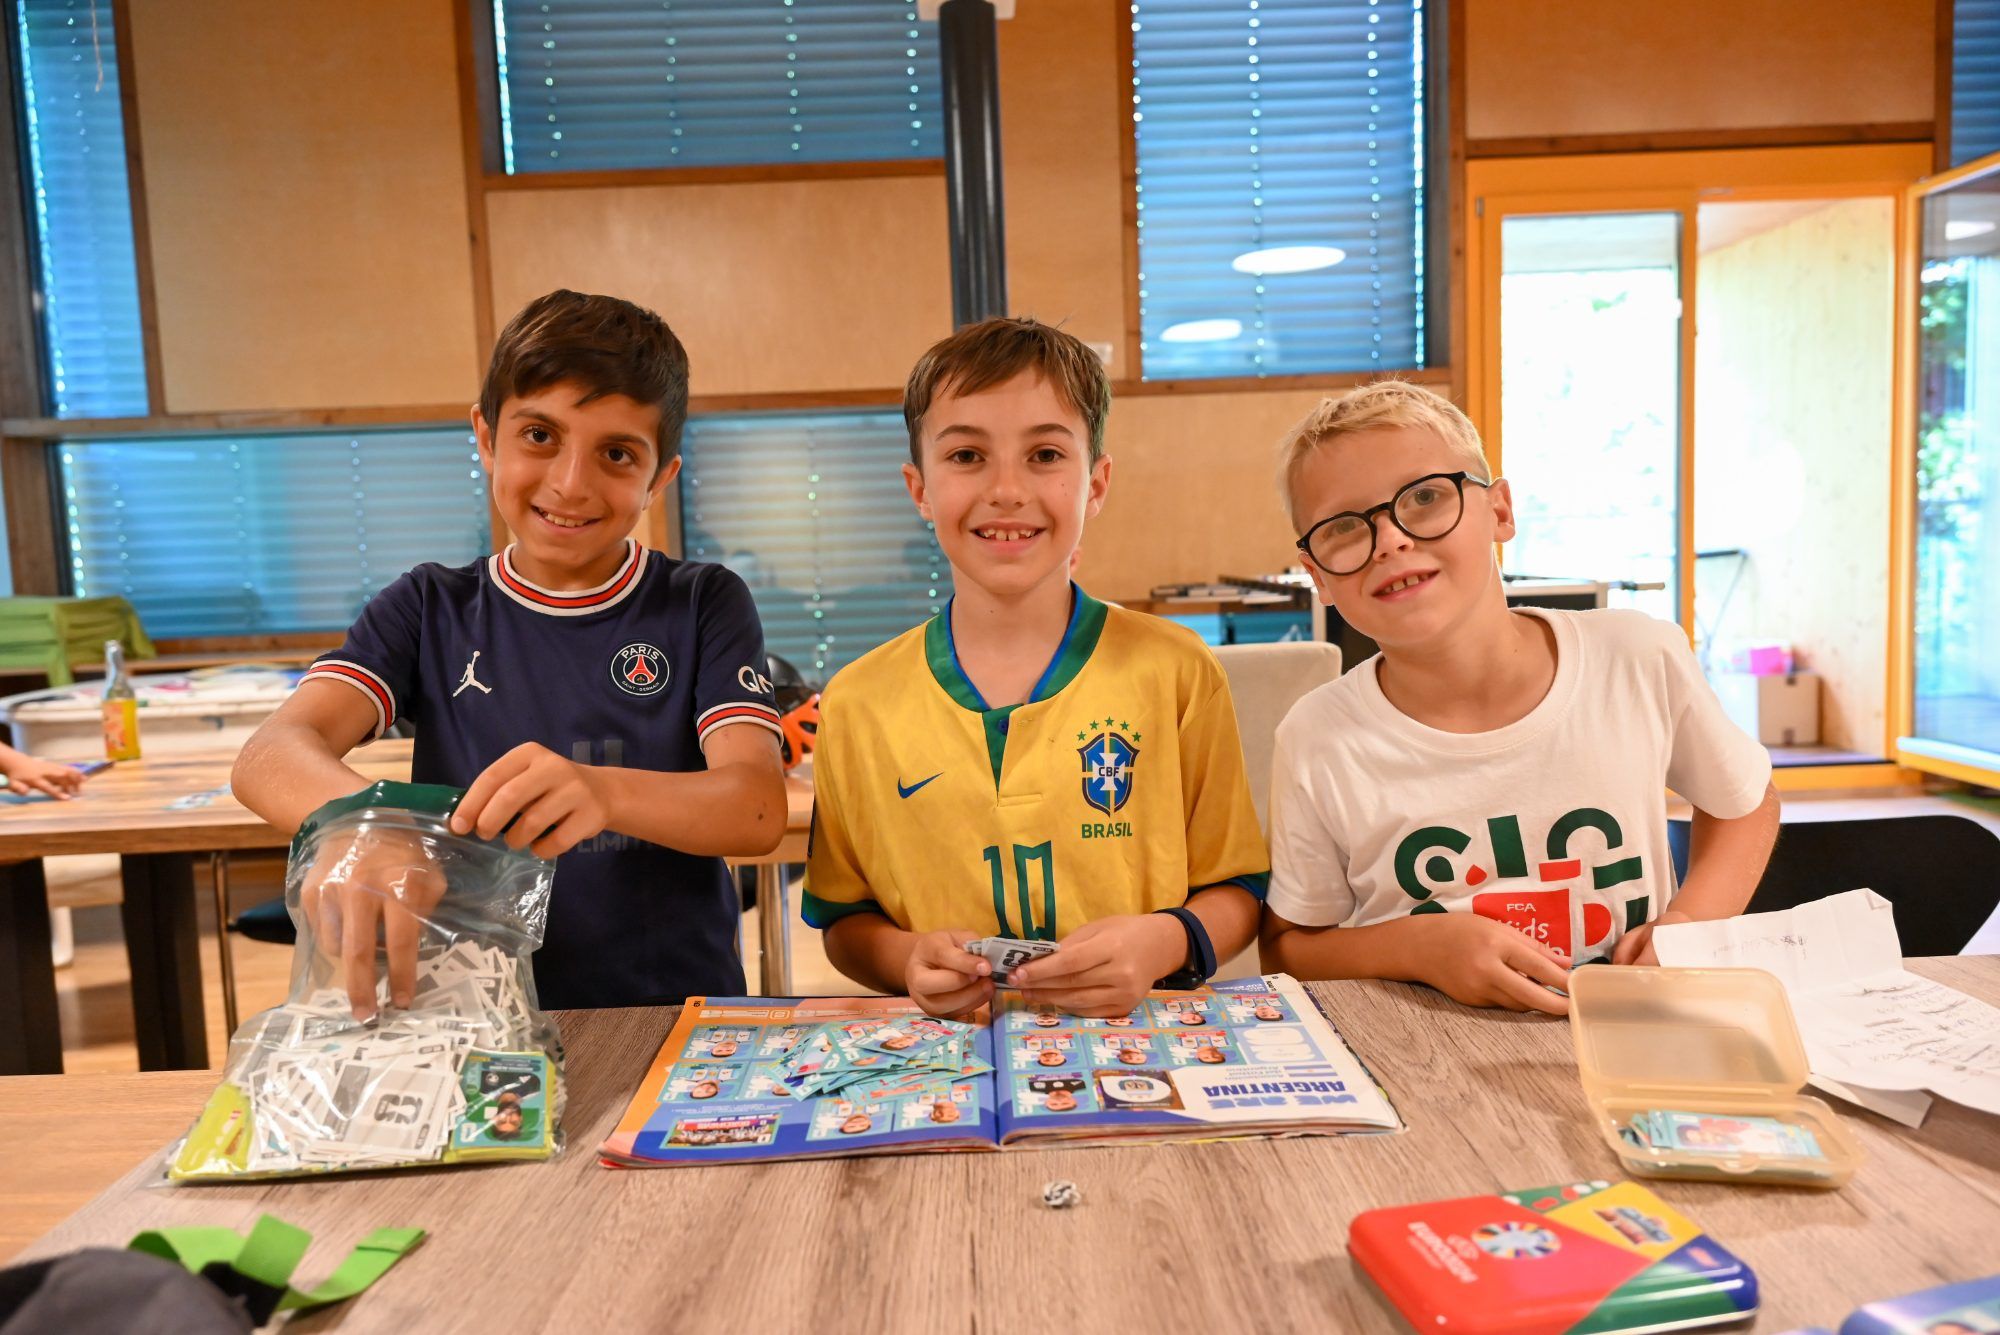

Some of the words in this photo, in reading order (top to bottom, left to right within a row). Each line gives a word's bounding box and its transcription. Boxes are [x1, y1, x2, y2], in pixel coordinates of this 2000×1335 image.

[621, 646, 660, 660] PARIS
[1098, 766, 1120, 777] CBF
[1081, 822, 1133, 838] BRASIL
[983, 840, 1056, 942] 10
[1506, 903, 1537, 913] FCA
[1202, 1081, 1346, 1098] ARGENTINA
